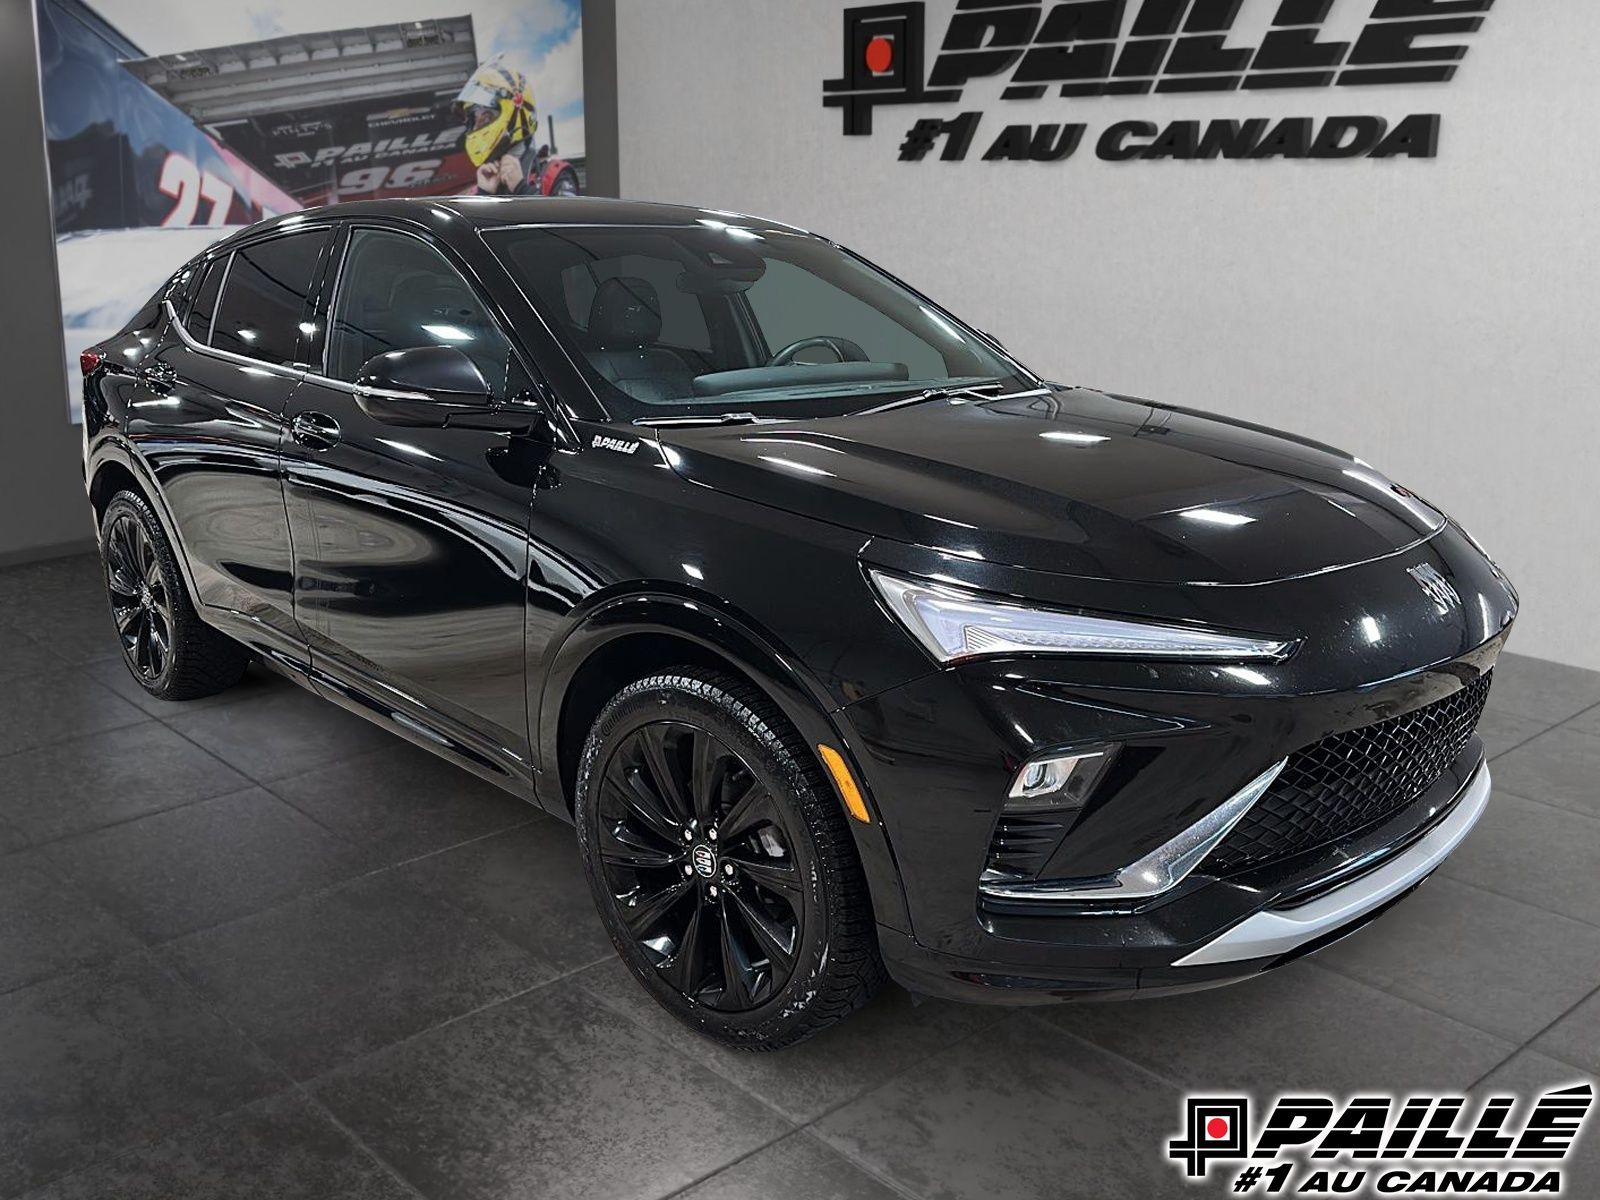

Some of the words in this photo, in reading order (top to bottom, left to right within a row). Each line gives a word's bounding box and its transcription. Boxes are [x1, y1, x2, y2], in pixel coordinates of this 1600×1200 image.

[897, 111, 984, 161] #1
[981, 123, 1087, 161] AU
[1095, 114, 1441, 161] CANADA
[159, 152, 234, 229] 27
[337, 159, 442, 195] 96
